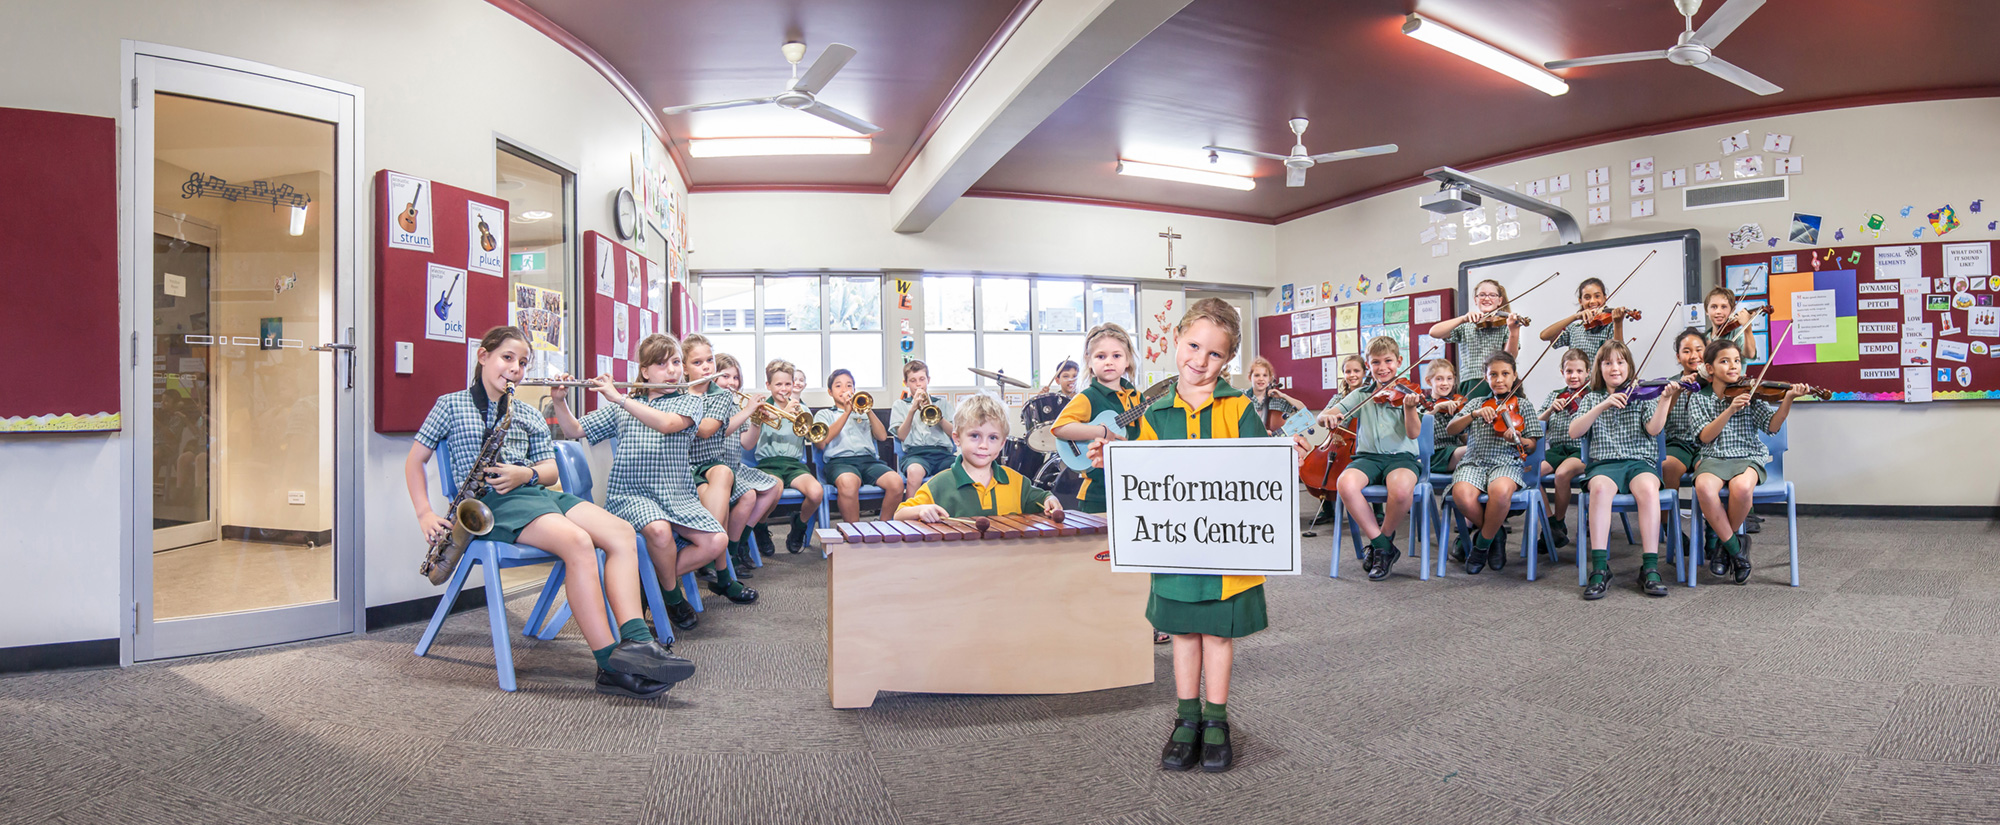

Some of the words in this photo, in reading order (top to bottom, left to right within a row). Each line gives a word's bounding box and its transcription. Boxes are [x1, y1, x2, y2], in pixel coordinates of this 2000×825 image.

[400, 233, 430, 246] strum
[479, 253, 501, 267] pluck
[1860, 284, 1898, 292] DYNAMICS
[444, 320, 463, 335] pick
[1860, 324, 1896, 332] TEXTURE
[1864, 345, 1894, 353] TEMPO
[1863, 370, 1896, 378] RHYTHM
[1120, 474, 1283, 502] Performance
[1131, 515, 1187, 545] Arts
[1193, 515, 1275, 545] Centre
